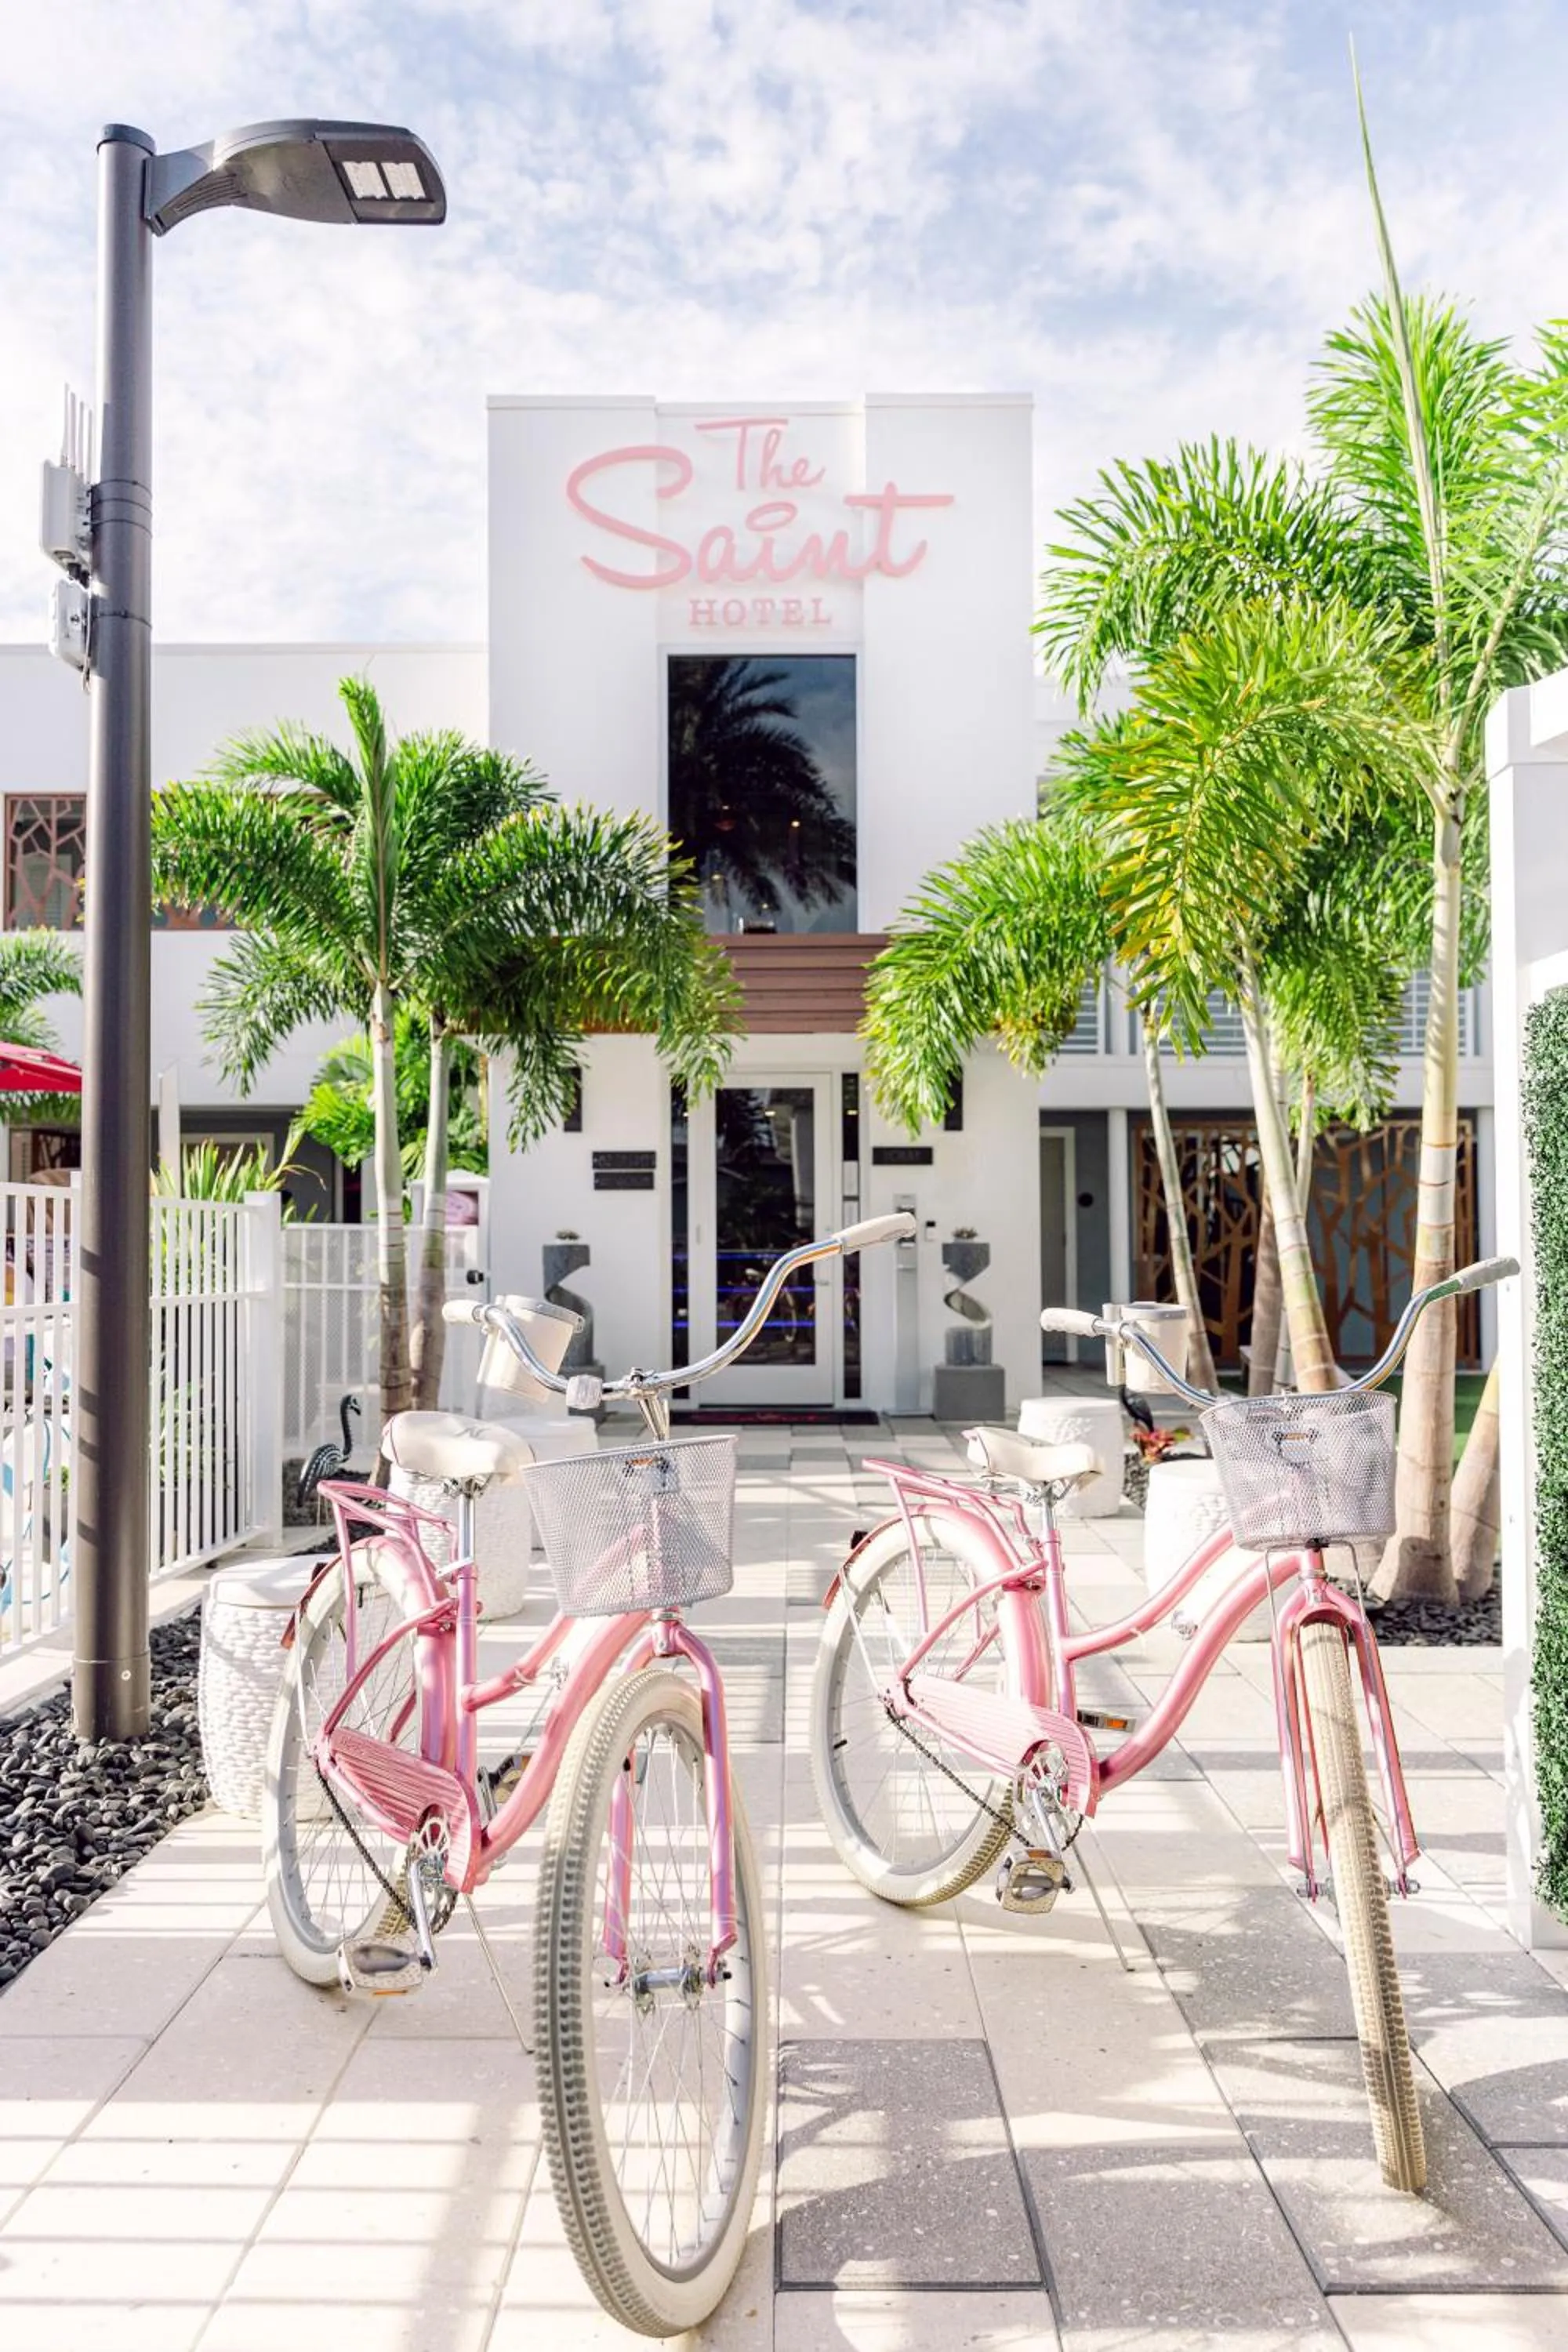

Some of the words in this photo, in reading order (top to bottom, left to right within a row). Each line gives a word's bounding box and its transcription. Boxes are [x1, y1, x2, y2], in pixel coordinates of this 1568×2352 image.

[695, 417, 826, 492] The
[565, 445, 955, 590] Saint
[688, 597, 833, 627] HOTEL
